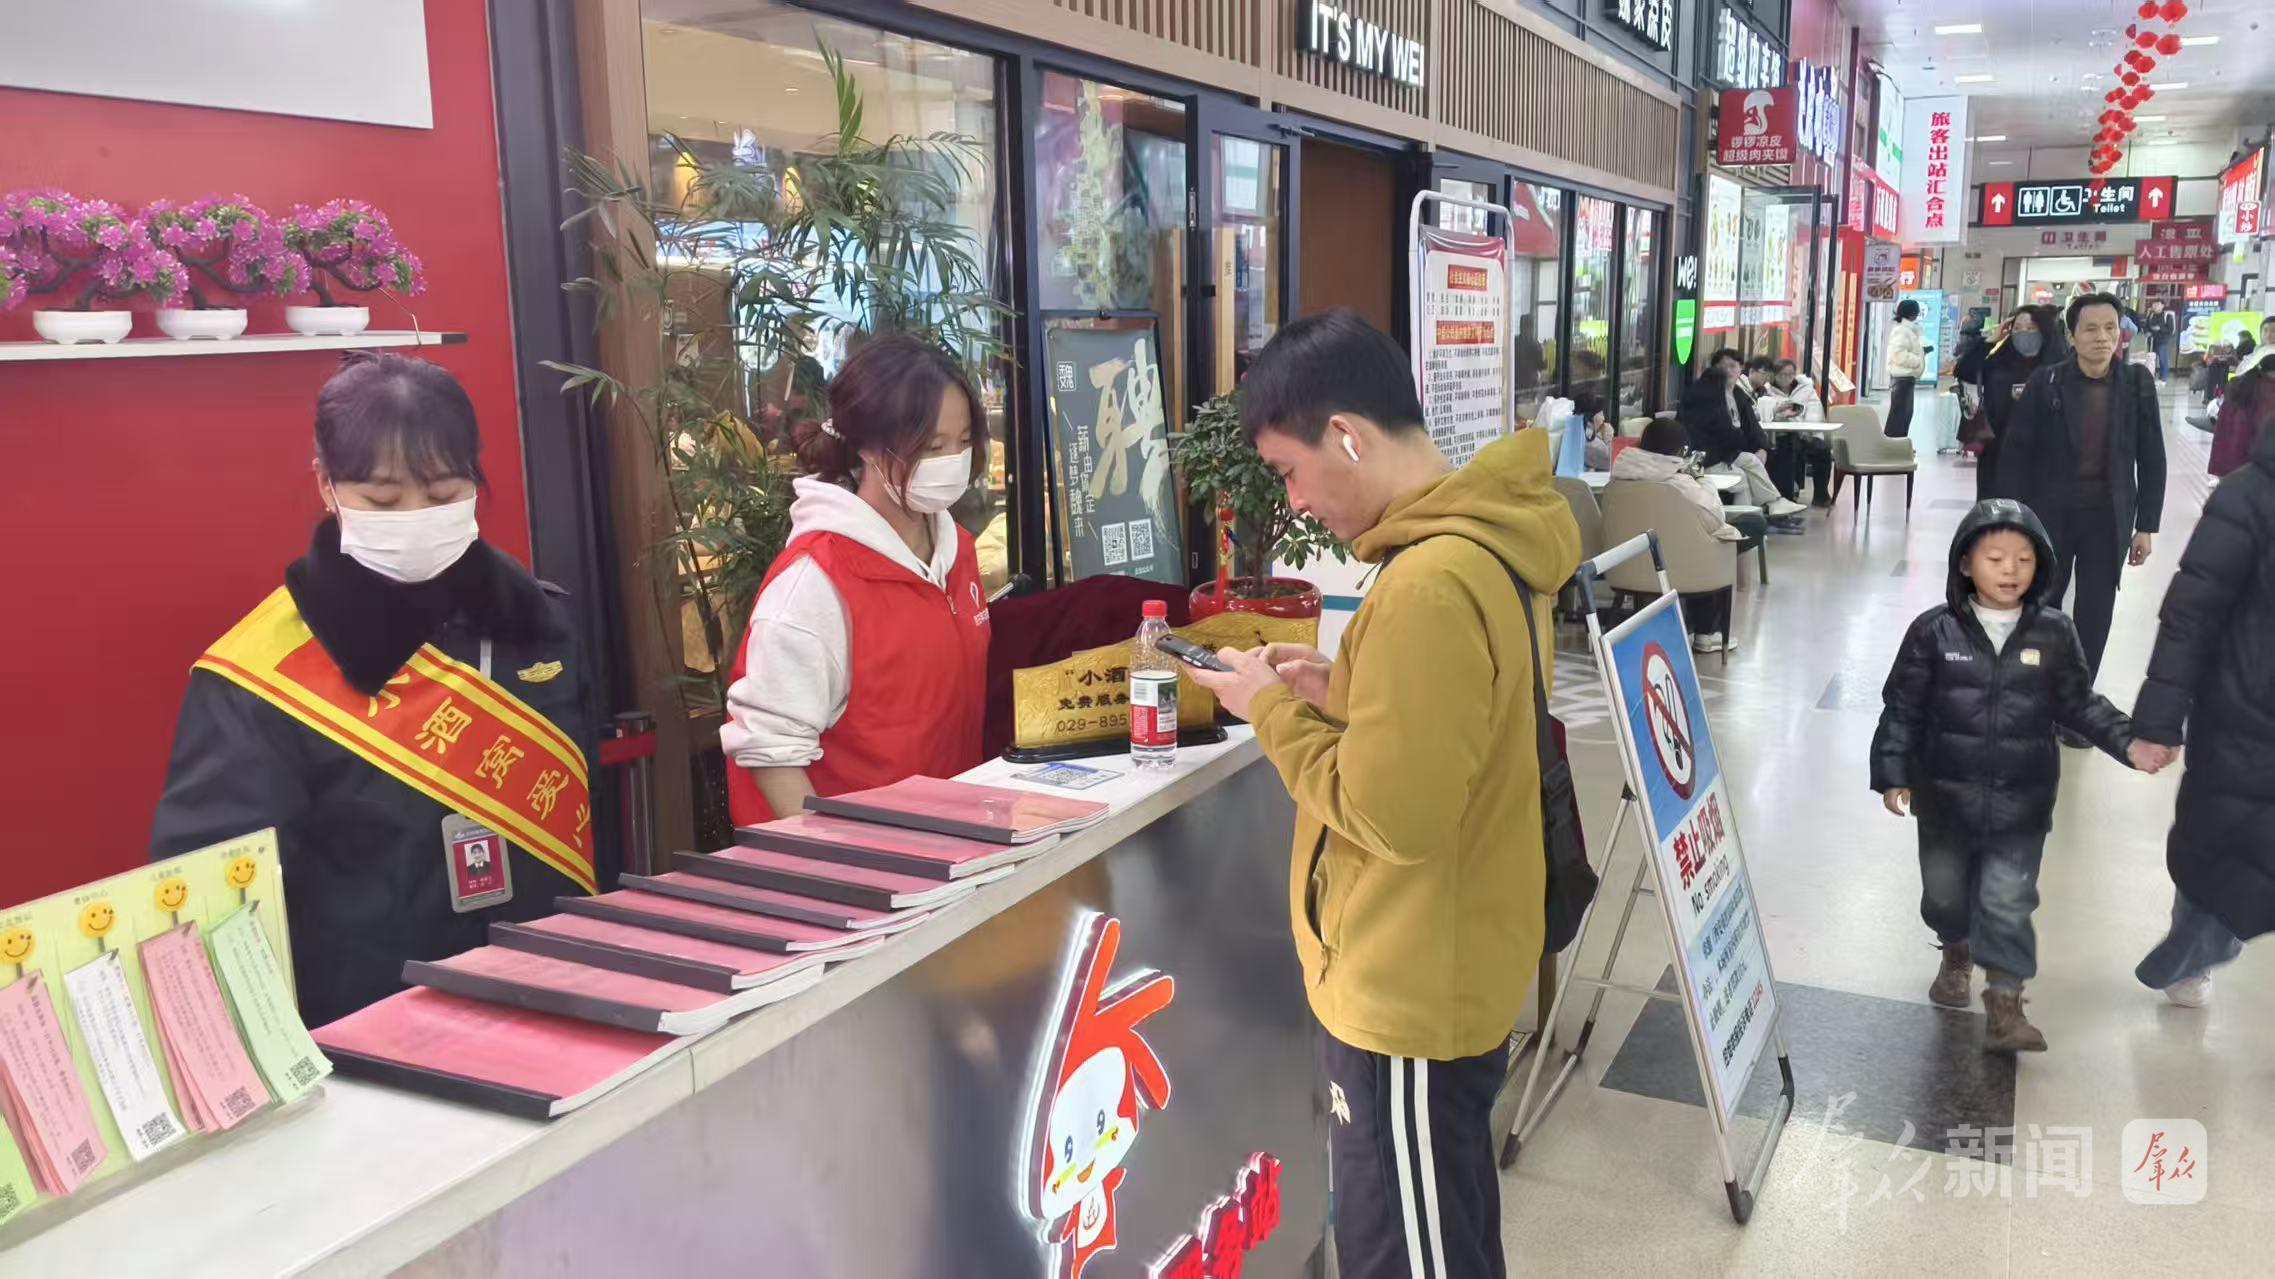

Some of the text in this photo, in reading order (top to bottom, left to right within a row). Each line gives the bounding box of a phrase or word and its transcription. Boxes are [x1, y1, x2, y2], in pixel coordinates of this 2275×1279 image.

[1311, 0, 1351, 62] IT'S
[1356, 18, 1388, 73] MY
[1925, 111, 1951, 229] 旅客出站汇合点
[2093, 203, 2125, 214] Toilet
[2139, 245, 2214, 259] 人工售票处
[1673, 791, 1725, 892] 禁止吸烟
[1691, 891, 1704, 917] No
[1704, 853, 1731, 901] smoking
